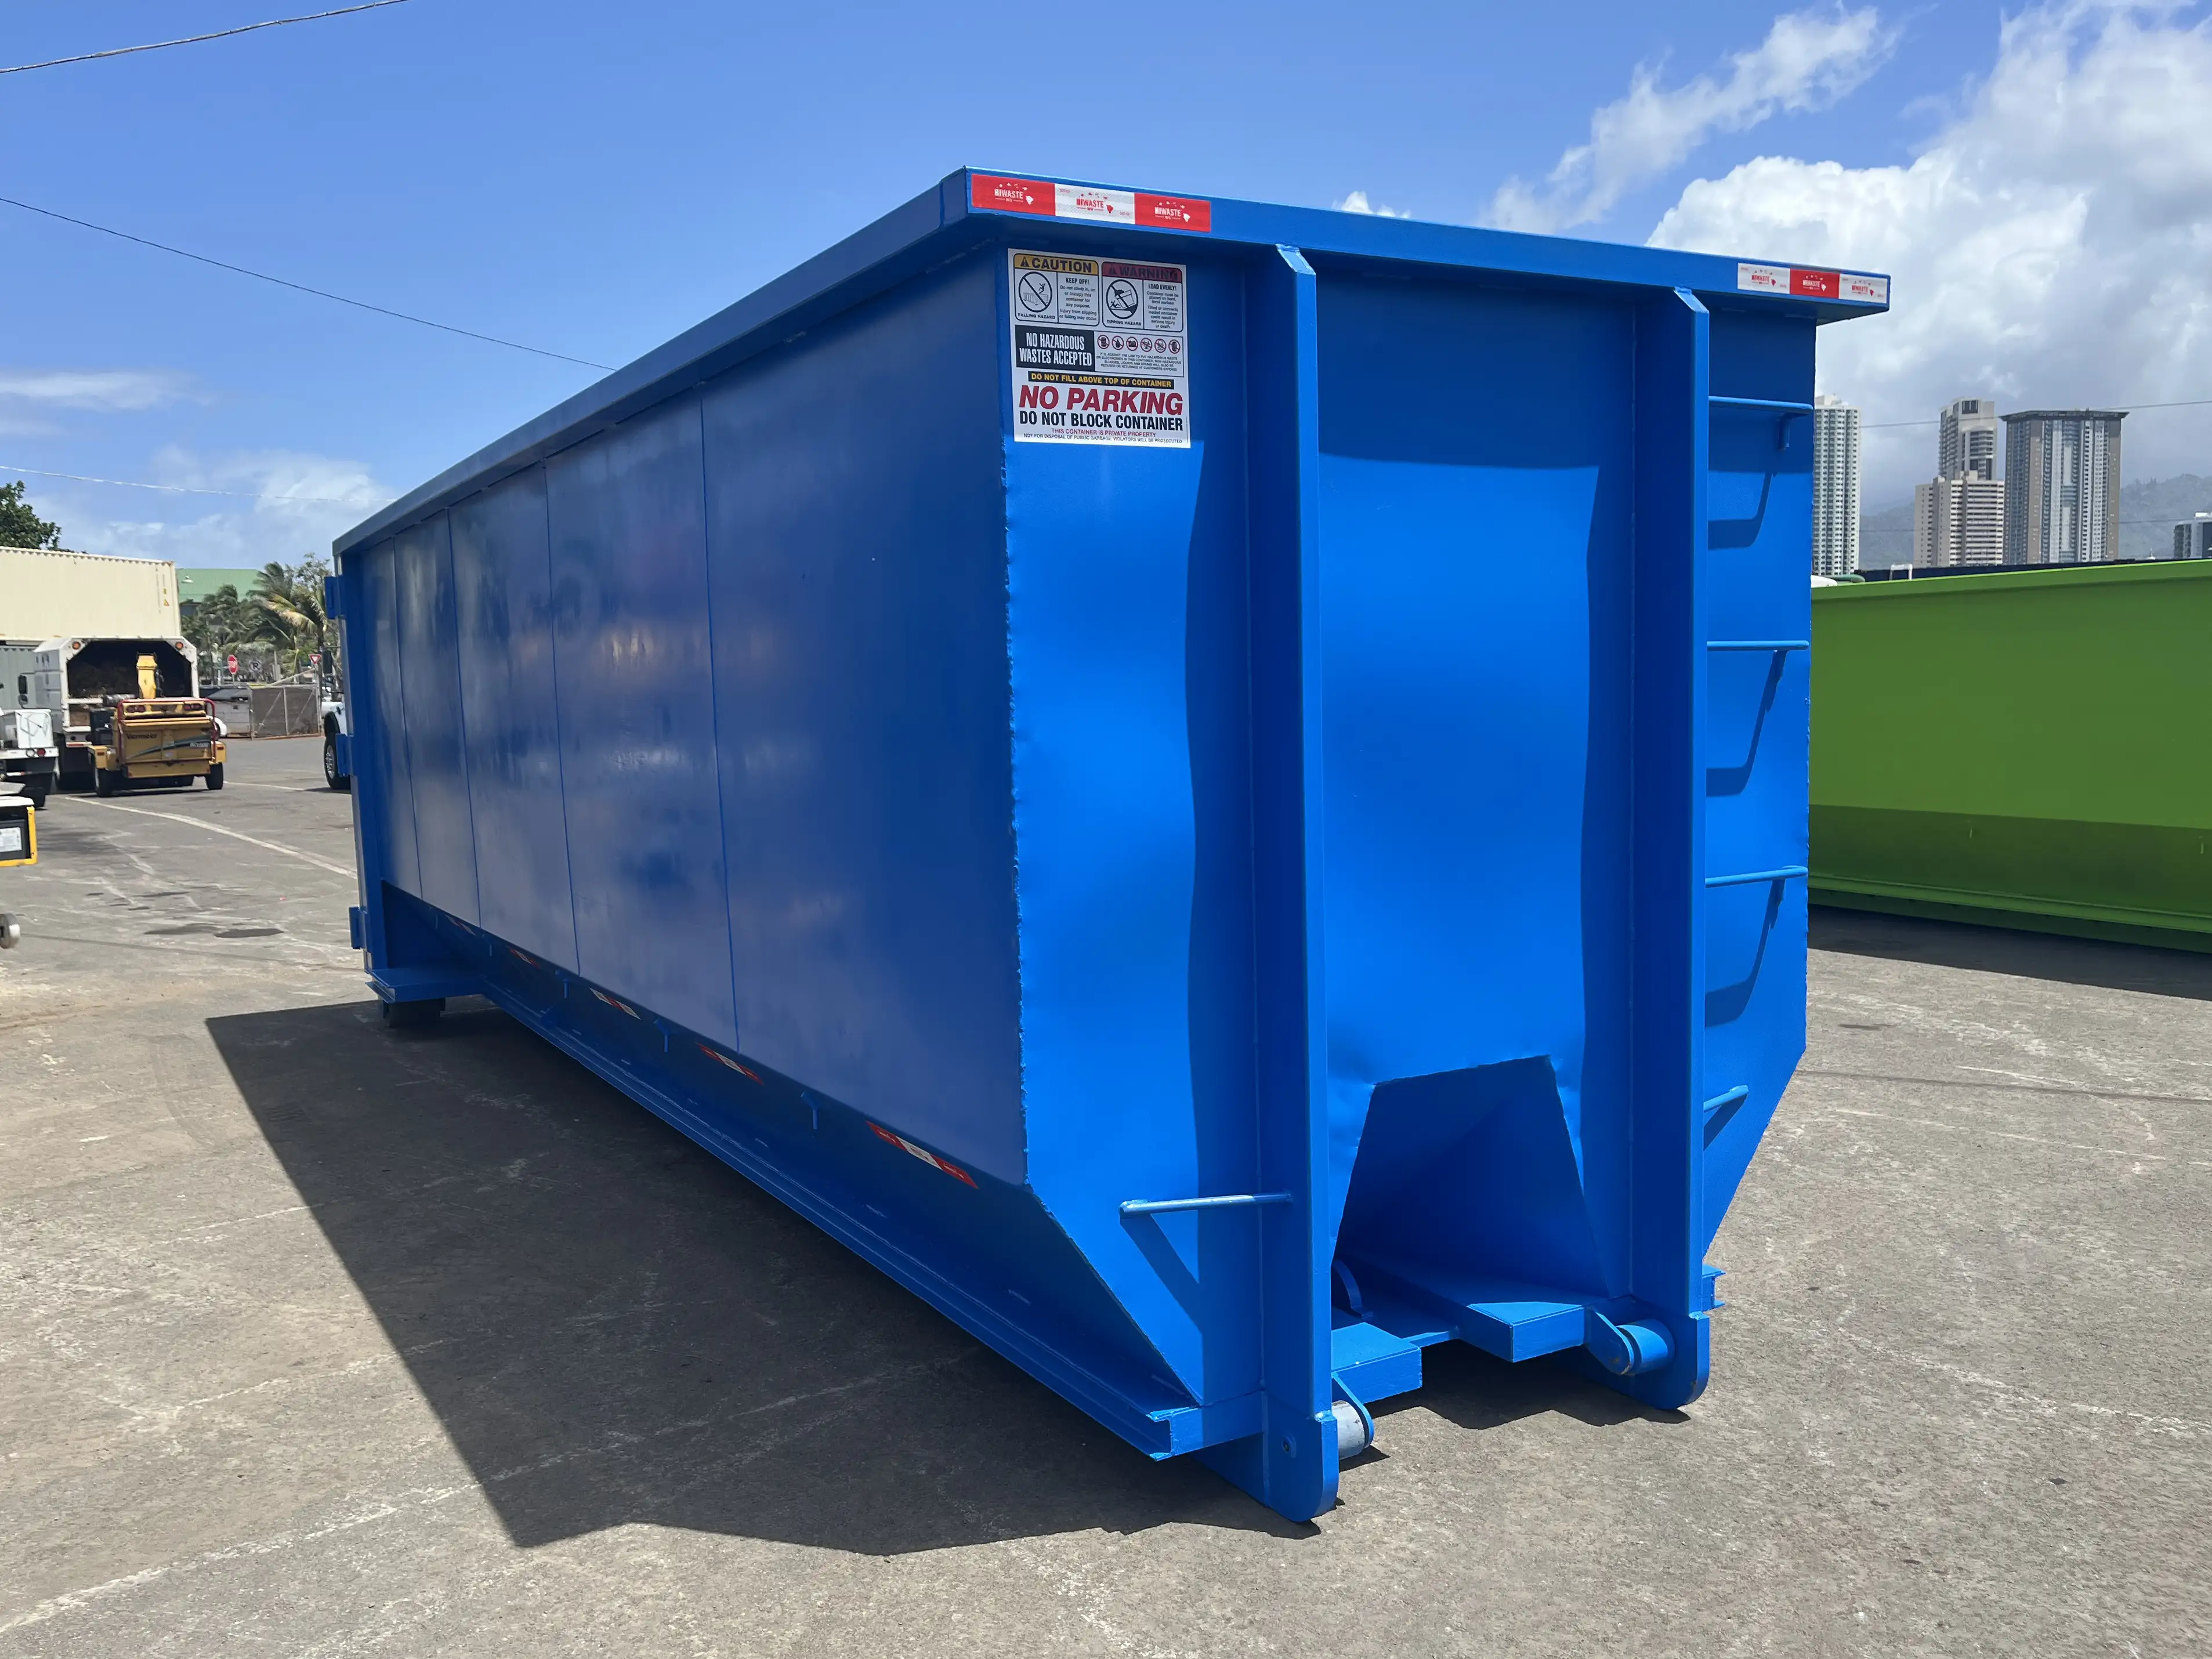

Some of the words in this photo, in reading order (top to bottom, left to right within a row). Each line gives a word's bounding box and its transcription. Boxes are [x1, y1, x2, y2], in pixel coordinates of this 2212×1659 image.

[1032, 257, 1092, 273] CAUTION
[1120, 267, 1178, 281] WARNING
[1026, 332, 1038, 347] NO
[1040, 333, 1085, 350] HAZARDOUS
[1019, 347, 1051, 364] WASTES
[1053, 350, 1092, 366] ACCEPTED
[1132, 379, 1172, 387] CONTAINER
[1019, 385, 1059, 410] NO
[1066, 387, 1183, 415] PARKING
[1019, 410, 1037, 425] DO
[1041, 411, 1066, 426] NOT
[1071, 412, 1112, 428] BLOCK
[1116, 415, 1183, 431] CONTAINER
